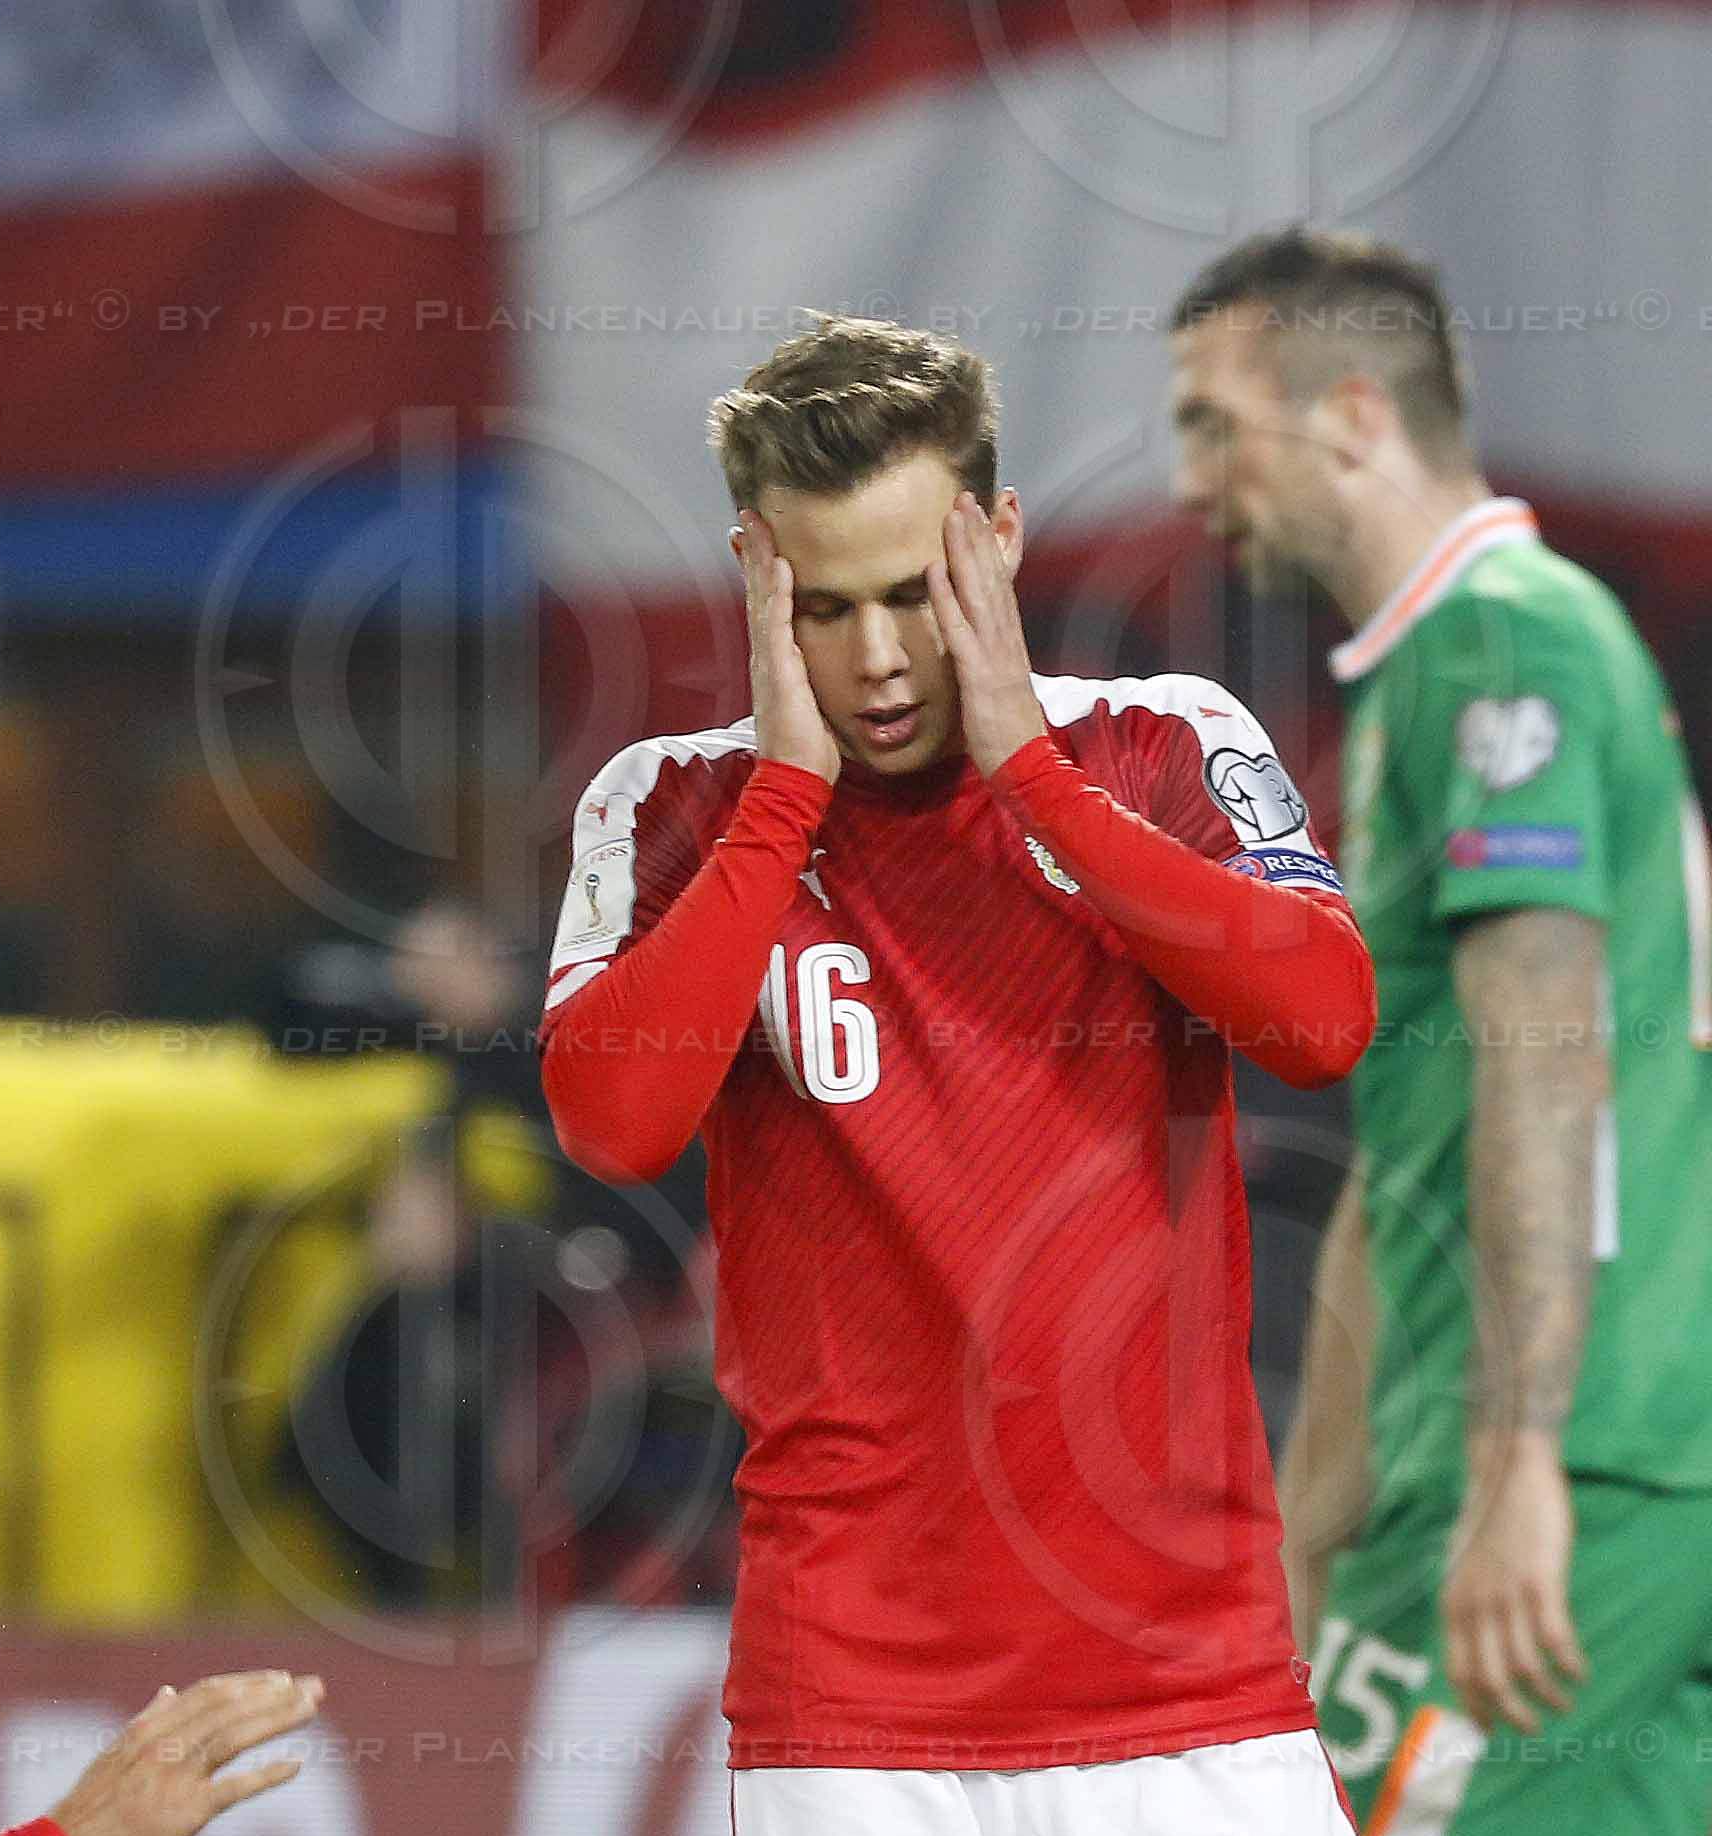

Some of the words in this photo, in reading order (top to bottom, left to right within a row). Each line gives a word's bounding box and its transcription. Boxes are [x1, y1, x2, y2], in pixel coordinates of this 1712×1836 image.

[1263, 854, 1344, 887] RESPEC
[756, 940, 882, 1105] 16
[1308, 1616, 1430, 1778] 15
